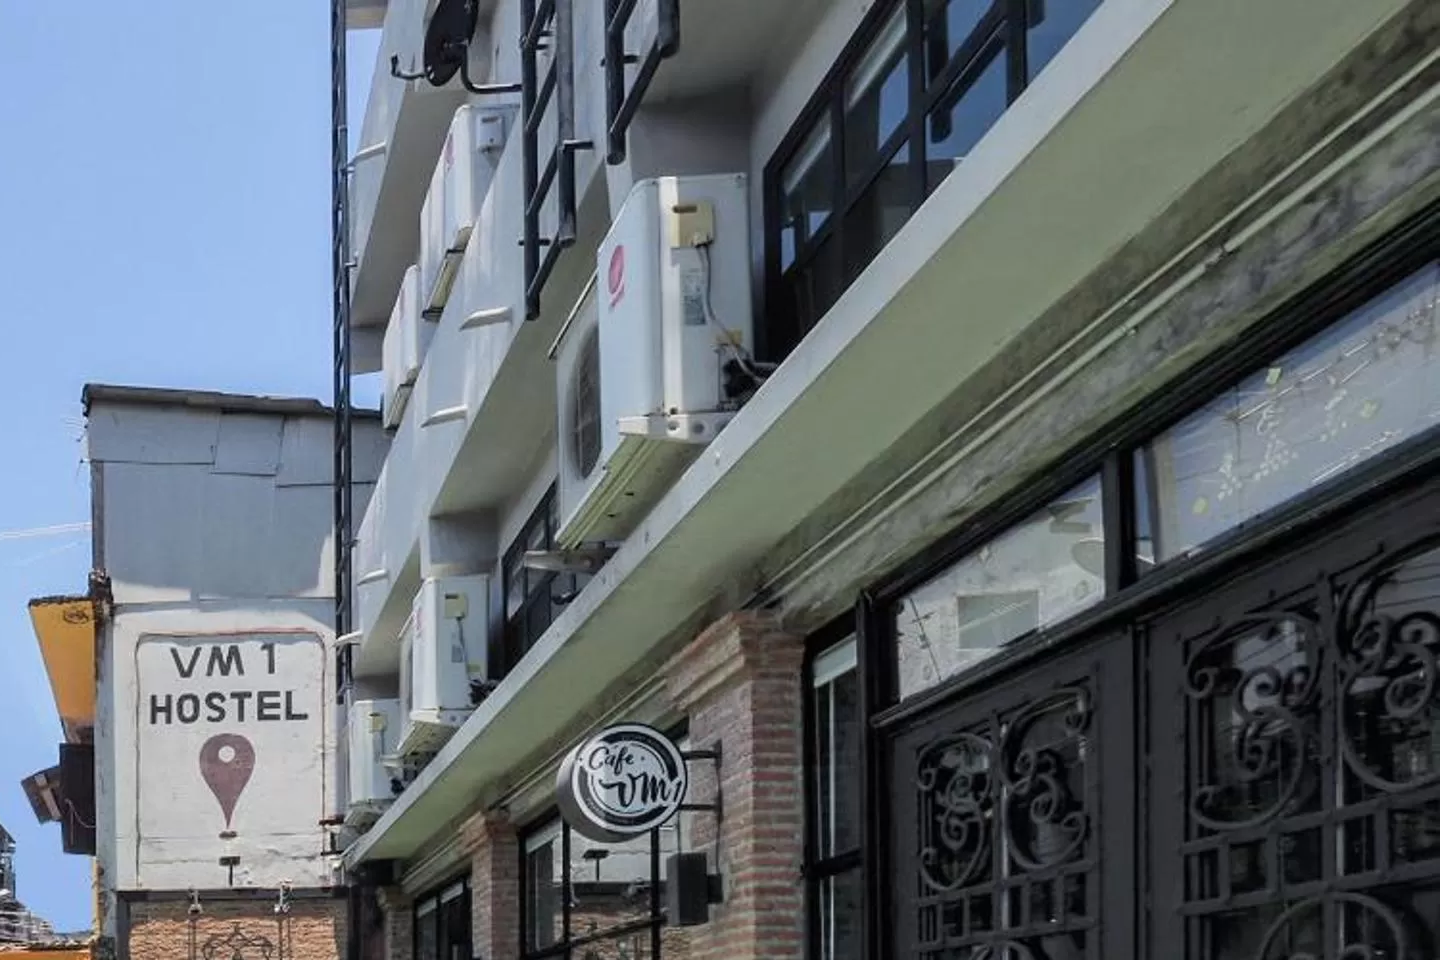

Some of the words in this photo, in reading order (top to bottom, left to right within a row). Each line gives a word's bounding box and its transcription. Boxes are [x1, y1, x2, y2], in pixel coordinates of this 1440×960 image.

[170, 644, 245, 679] VM
[260, 642, 276, 675] 1
[150, 690, 309, 725] HOSTEL
[588, 745, 635, 777] Cafe
